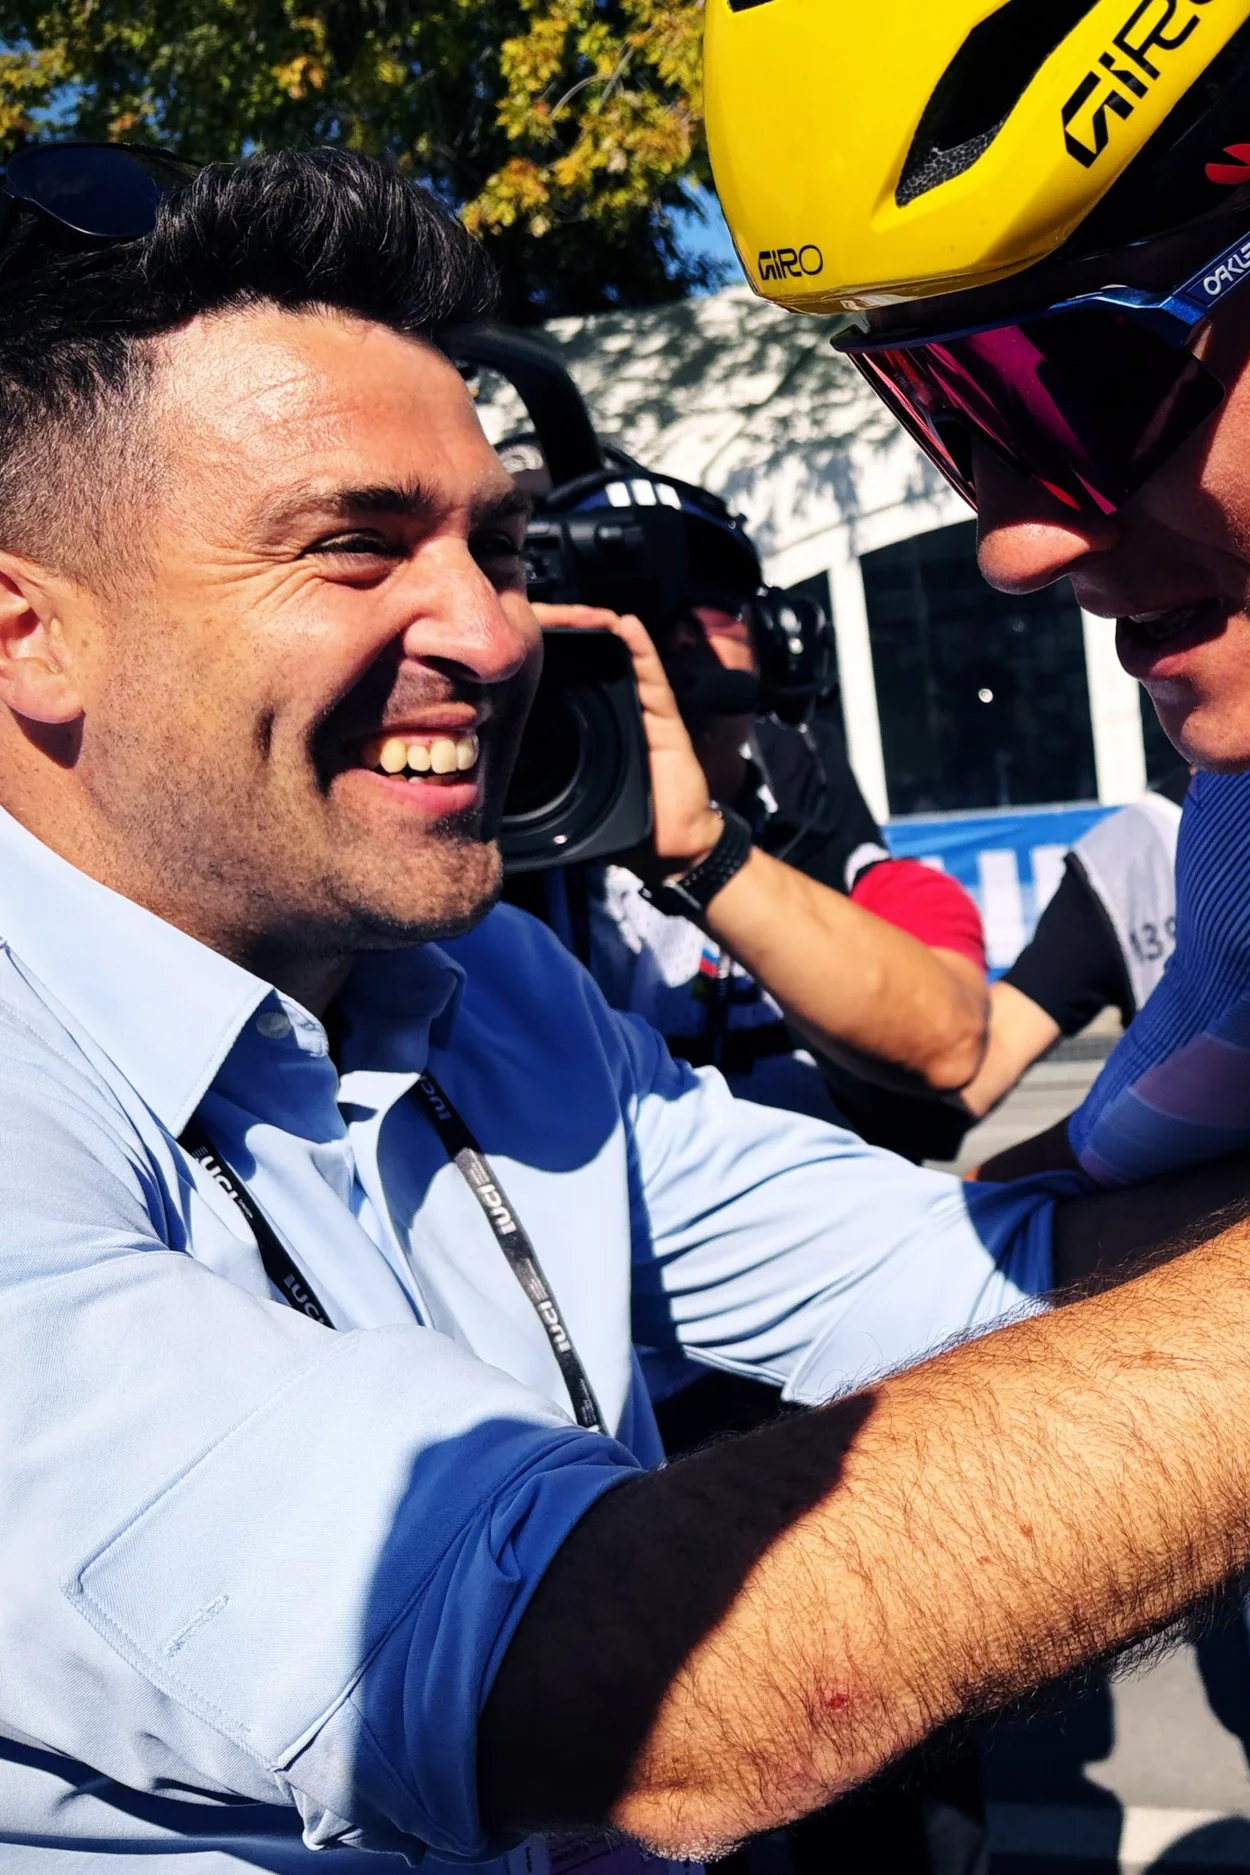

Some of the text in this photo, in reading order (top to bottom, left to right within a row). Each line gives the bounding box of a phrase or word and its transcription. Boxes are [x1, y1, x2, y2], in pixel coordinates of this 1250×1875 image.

[1061, 0, 1214, 168] GIR
[758, 244, 824, 280] GIRO
[477, 1183, 512, 1229] UCI
[537, 1299, 567, 1346] UCI
